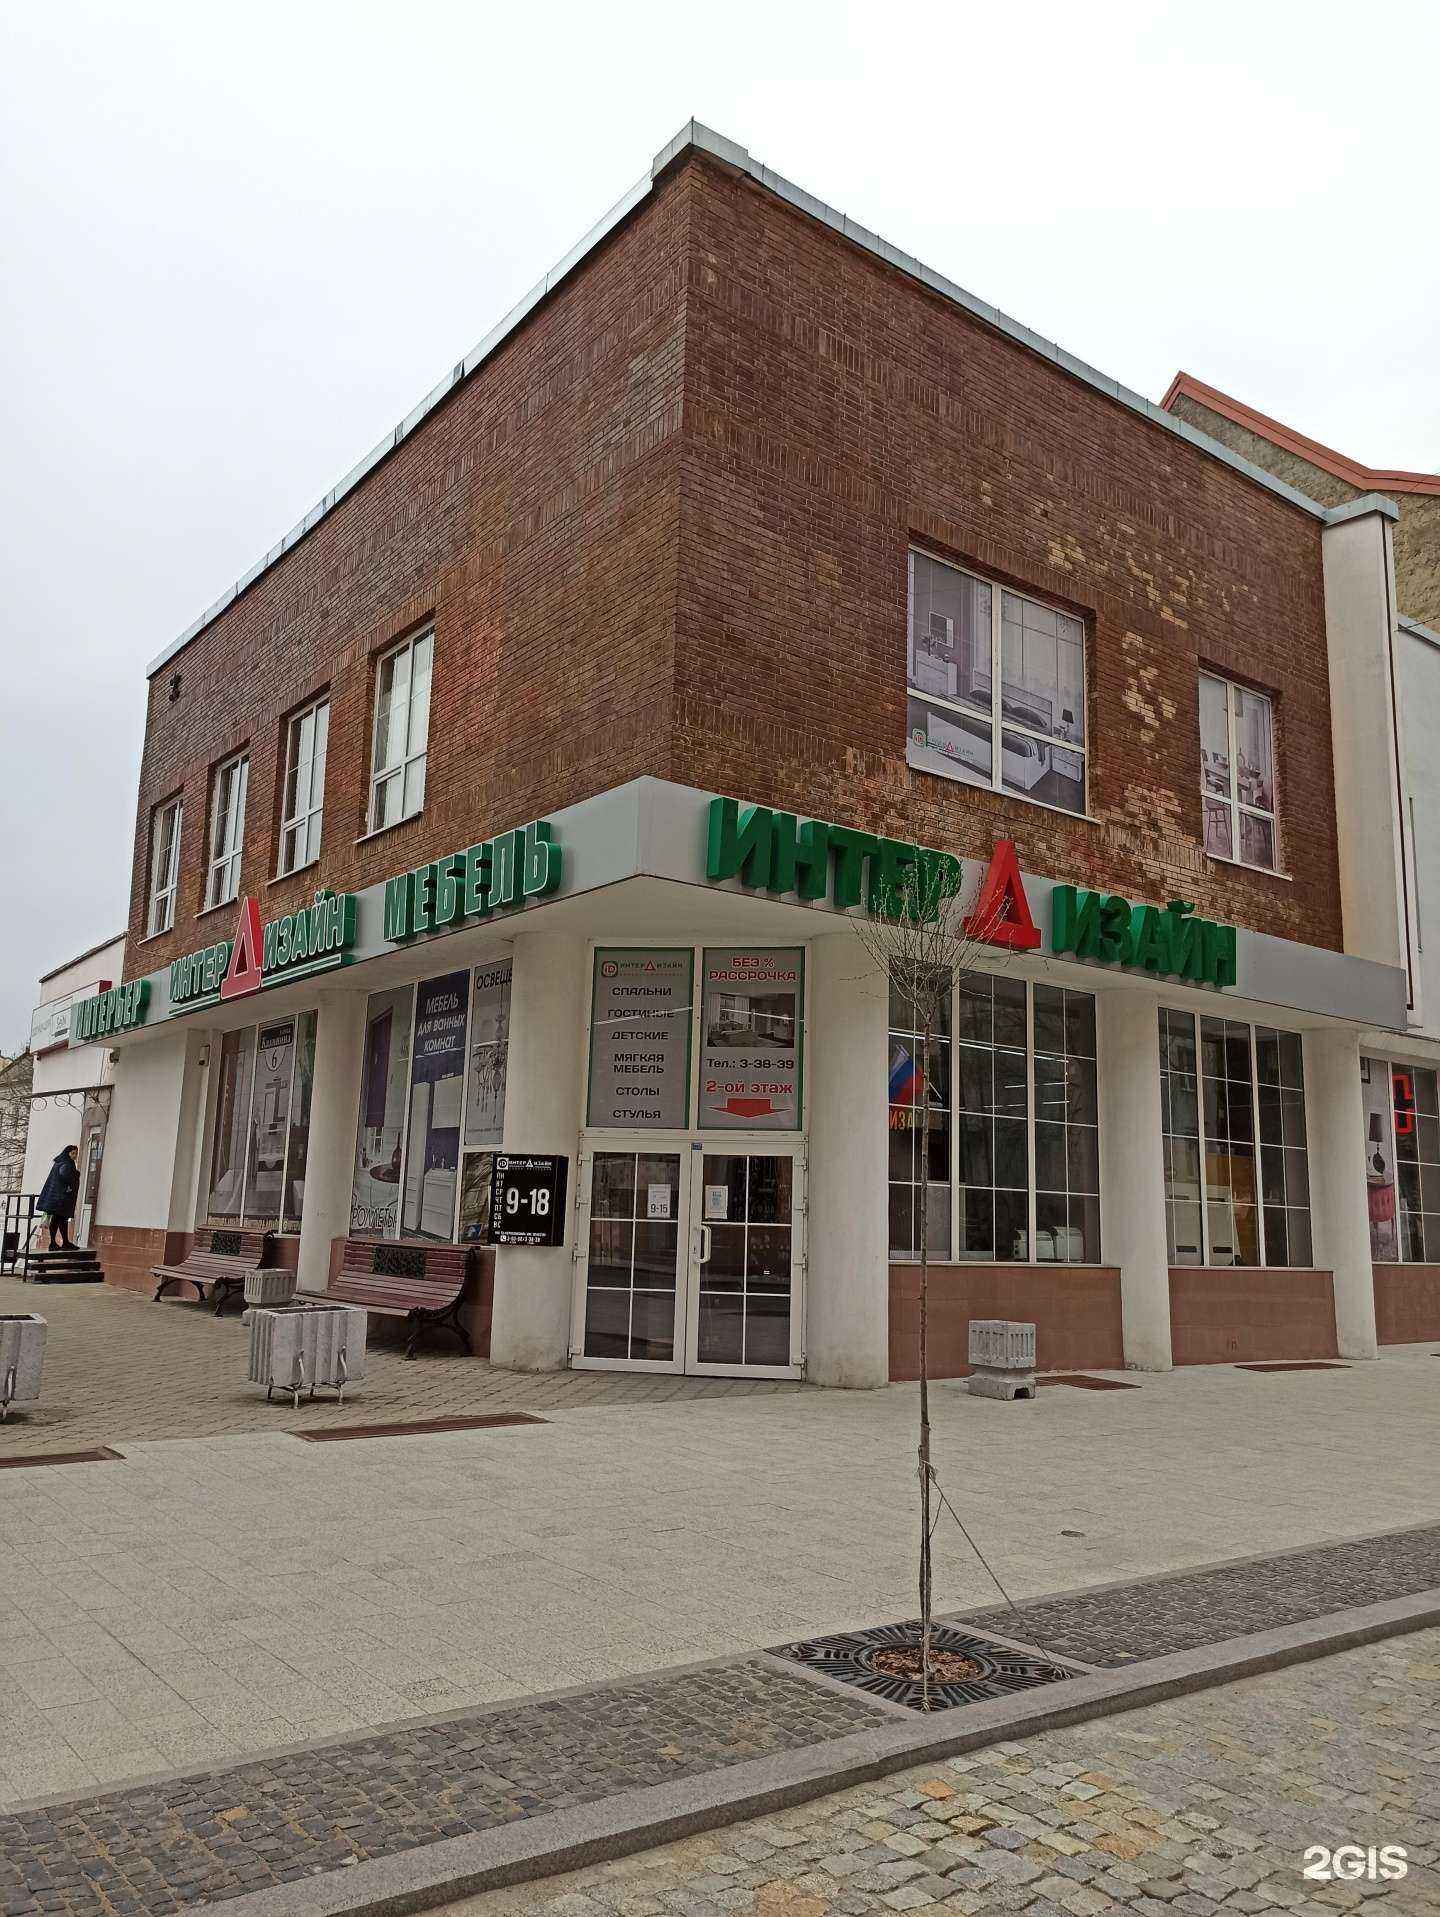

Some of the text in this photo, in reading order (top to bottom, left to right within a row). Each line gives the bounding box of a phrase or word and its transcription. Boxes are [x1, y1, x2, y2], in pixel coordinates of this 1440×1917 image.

[72, 979, 151, 1040] ИНТЕРЬЕР
[384, 820, 562, 943] МЕБЕЛЬ
[732, 957, 774, 968] БЕЗ %
[709, 971, 796, 981] РАССРОЧКА
[612, 987, 672, 996] СПАЛЬНИ
[425, 992, 458, 1015] МЕБЕЛЬ
[608, 1009, 675, 1019] ГОСТИНЫЕ
[611, 1031, 669, 1040] ДЕТСКИЕ
[271, 1048, 278, 1069] 6
[614, 1053, 665, 1062] МЯГКАЯ
[706, 1058, 794, 1069] Тел.: 3-38-39
[613, 1064, 665, 1074] МЕБЕЛЬ
[616, 1087, 660, 1096] СТОЛЫ
[706, 1080, 793, 1093] 2-ой этаж
[613, 1109, 661, 1119] СТУЛЬЯ
[506, 1187, 550, 1215] 9-18
[494, 1204, 502, 1212] ПТ
[650, 1203, 668, 1214] 9-15
